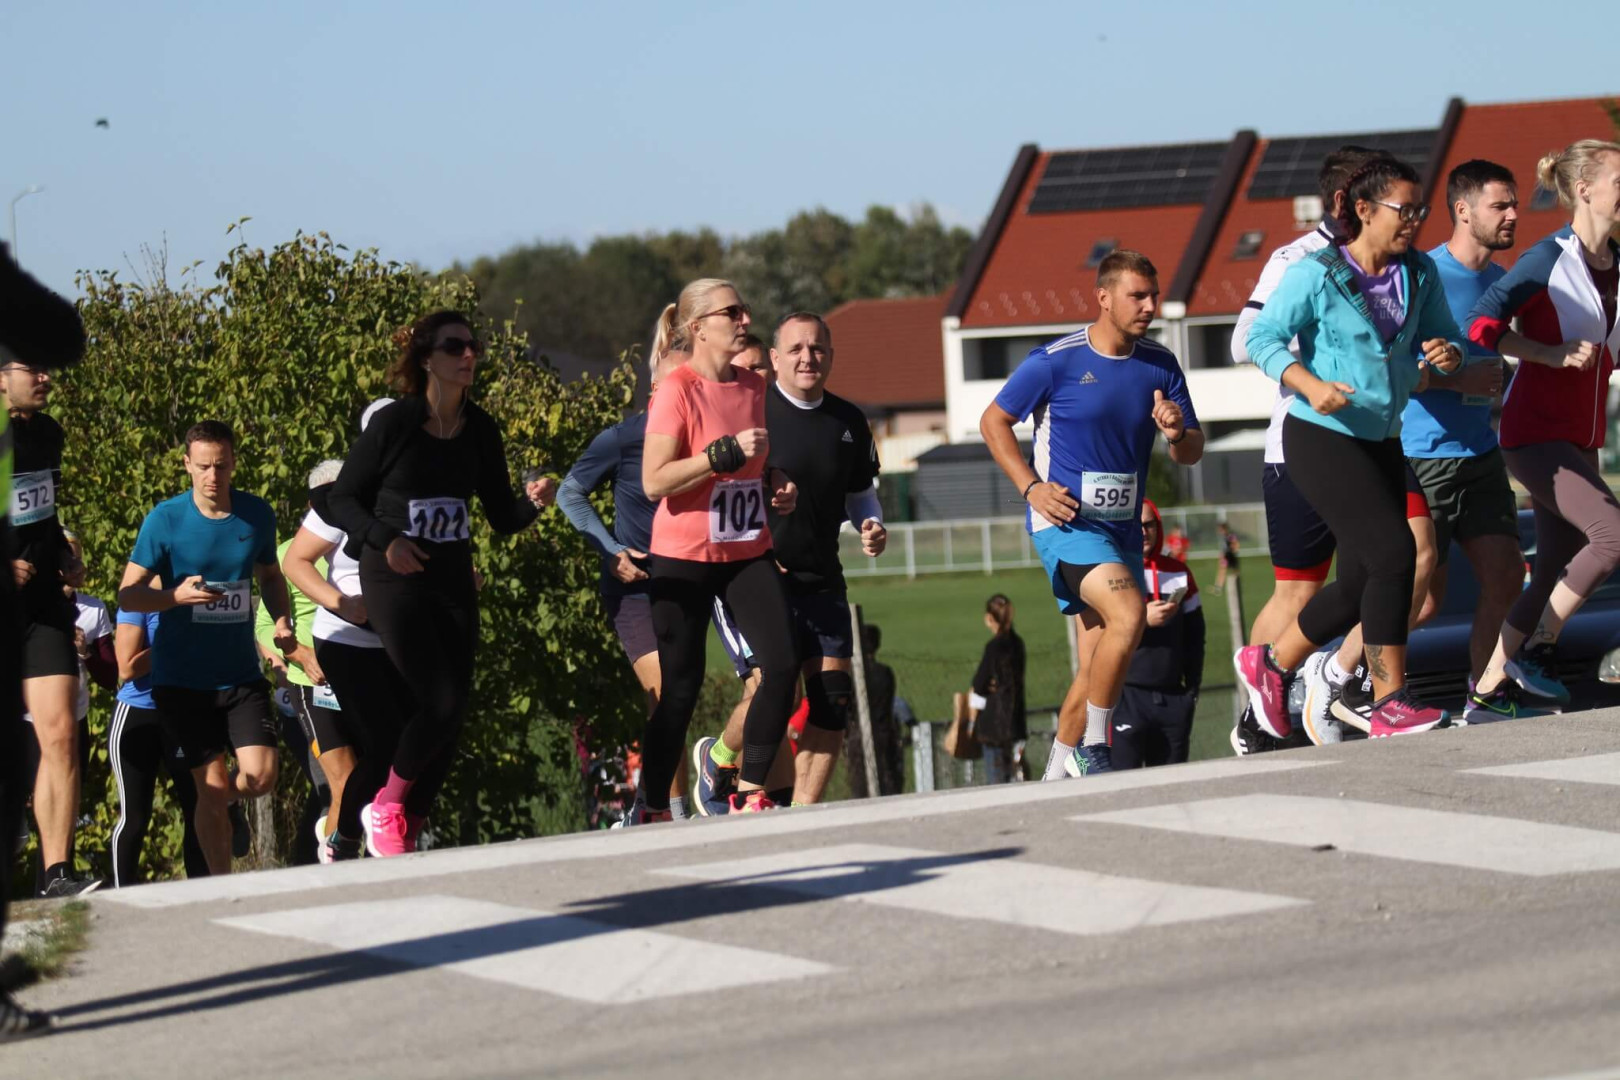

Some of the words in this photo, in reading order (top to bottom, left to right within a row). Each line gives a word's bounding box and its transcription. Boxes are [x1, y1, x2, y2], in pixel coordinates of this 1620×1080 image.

[18, 485, 50, 511] 572
[712, 488, 764, 532] 102
[1093, 487, 1131, 507] 595
[413, 506, 465, 539] 101
